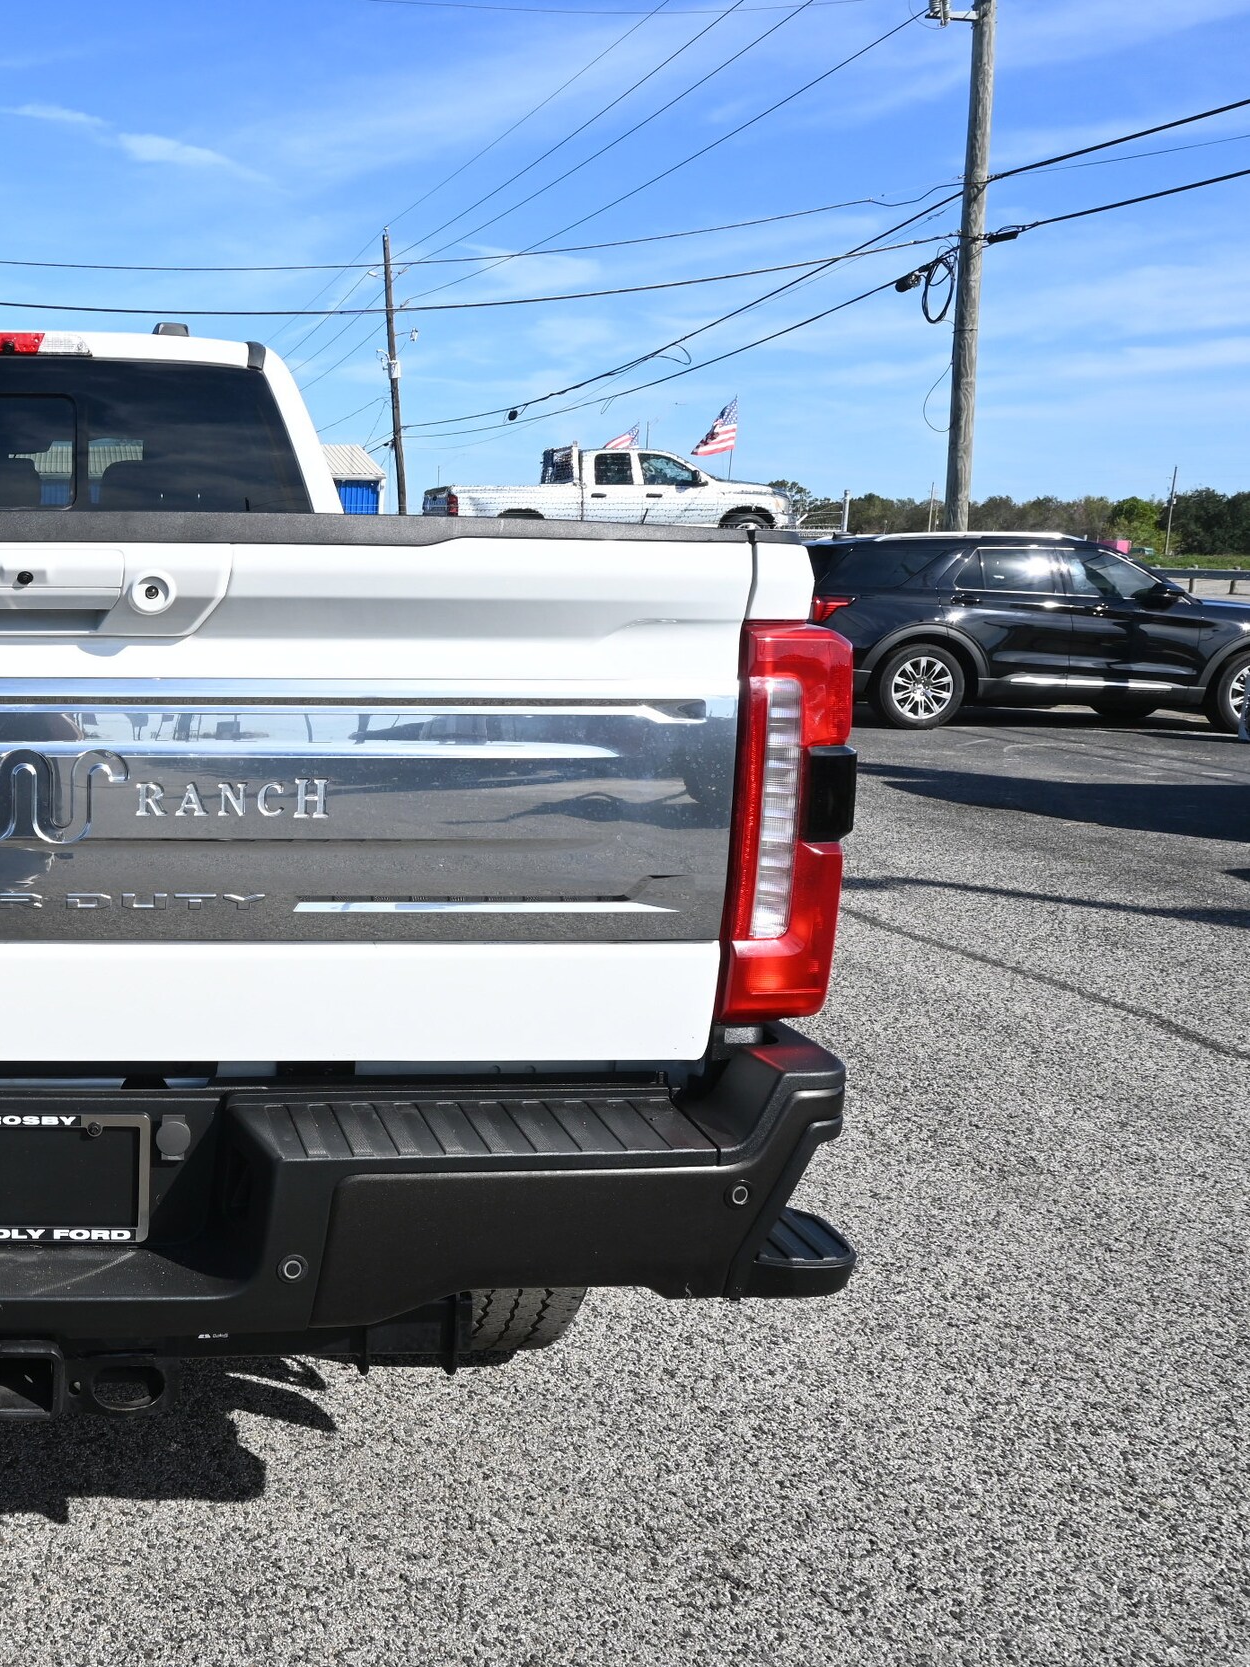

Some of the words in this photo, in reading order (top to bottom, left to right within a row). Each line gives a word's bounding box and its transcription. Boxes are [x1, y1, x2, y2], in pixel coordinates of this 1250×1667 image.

[135, 777, 331, 820] RANCH
[64, 892, 267, 911] DUTY
[53, 1229, 131, 1240] FORD
